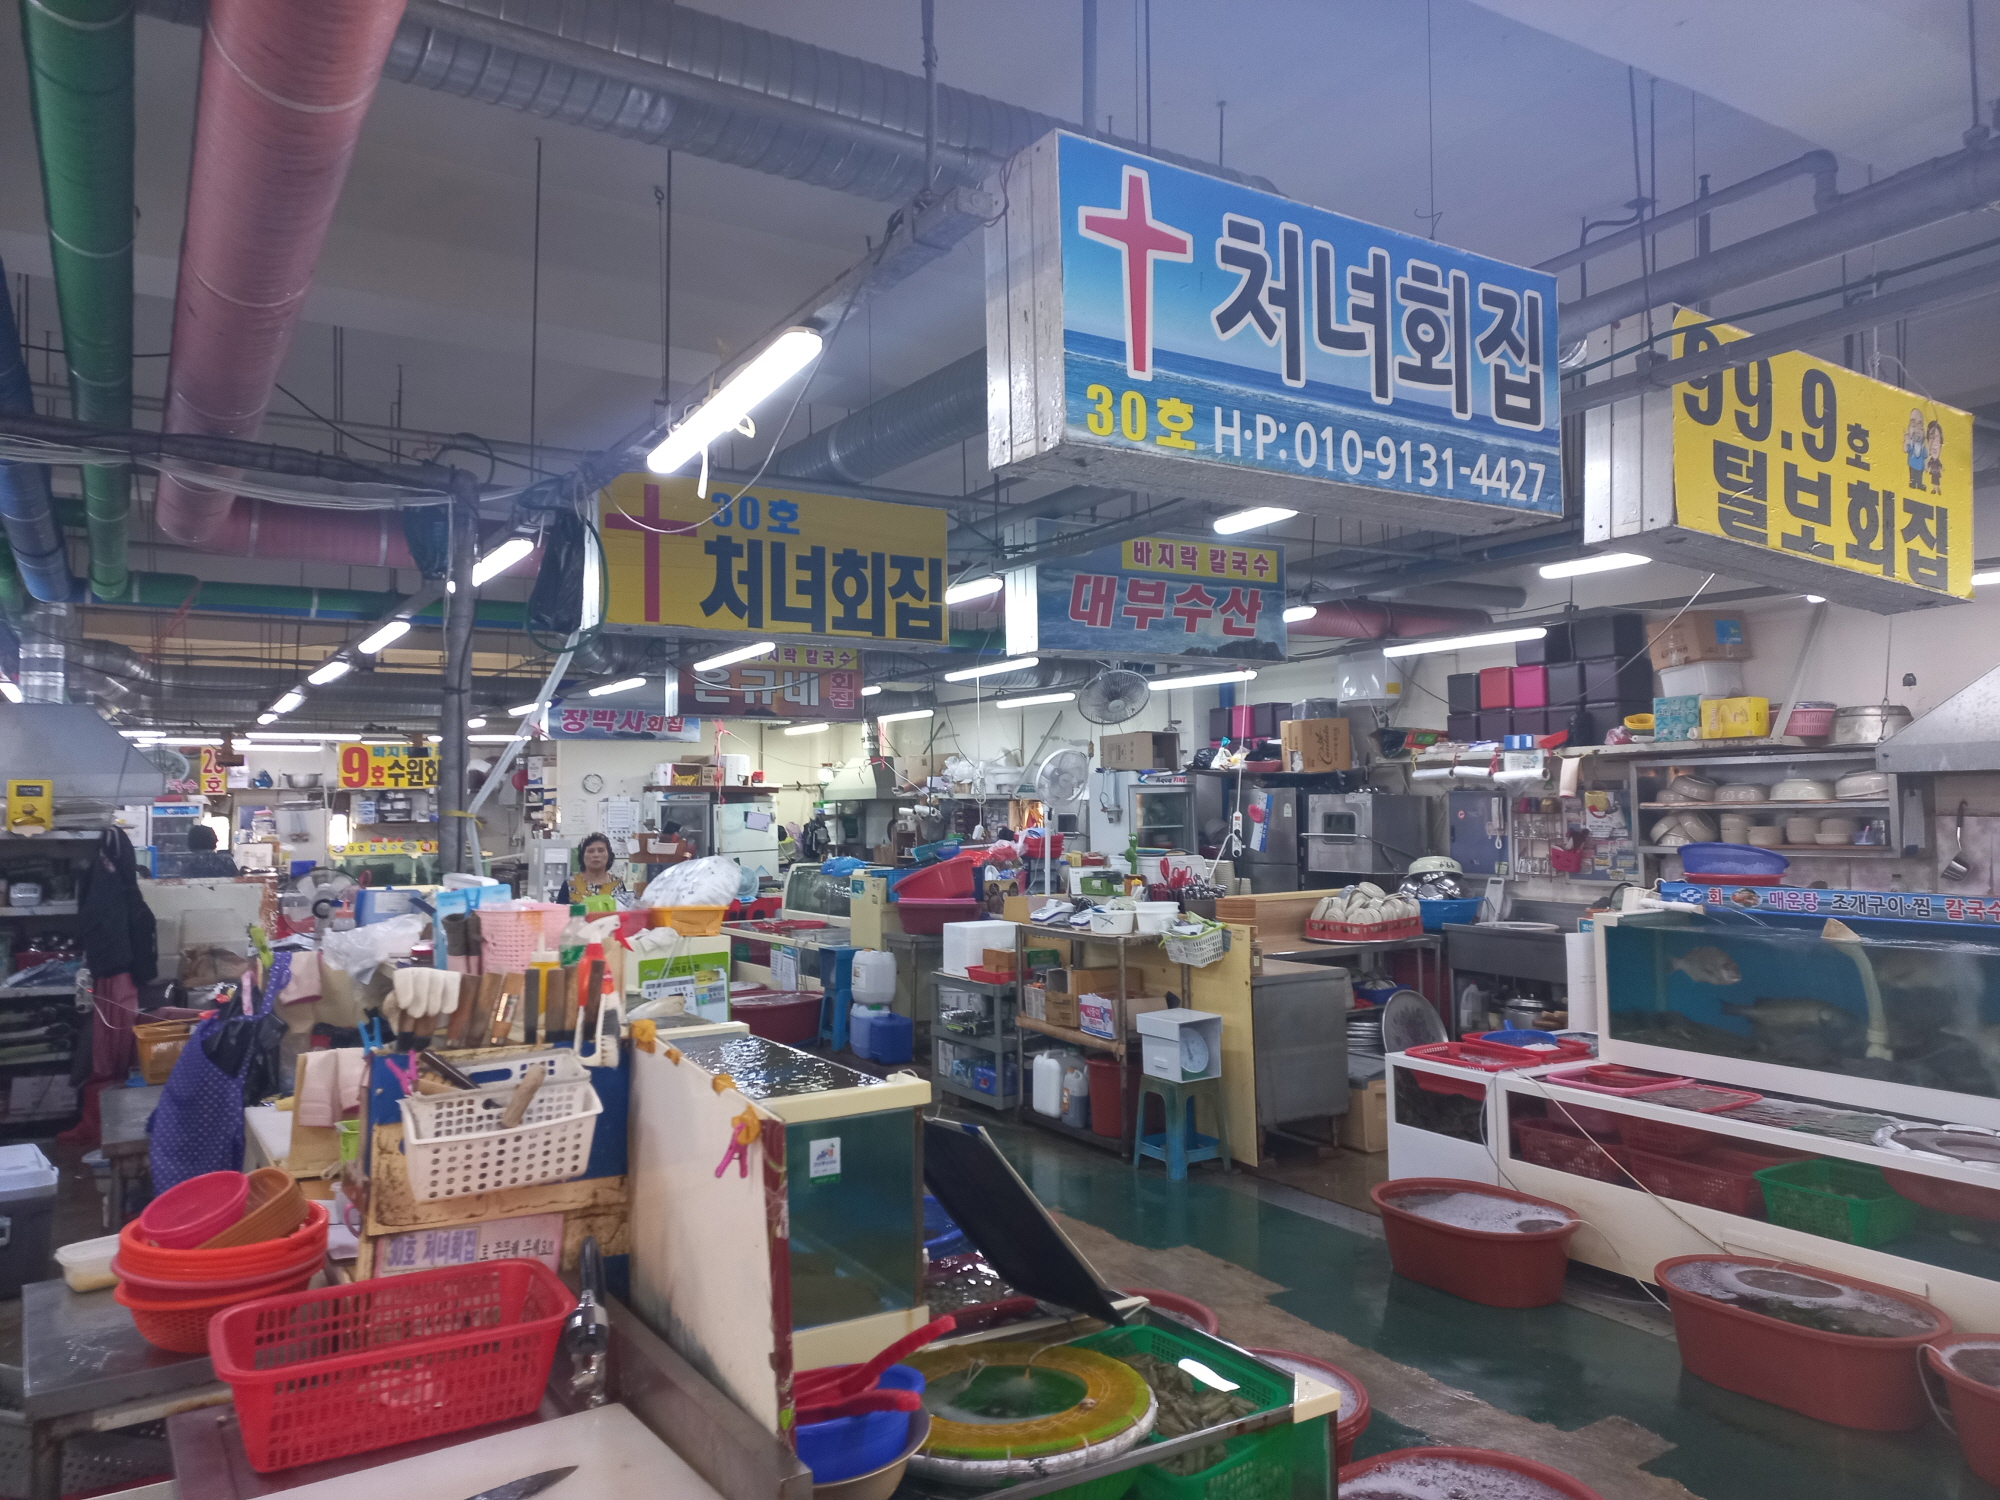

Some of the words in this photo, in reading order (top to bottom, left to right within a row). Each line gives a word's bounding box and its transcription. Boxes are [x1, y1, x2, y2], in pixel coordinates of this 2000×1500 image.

[1210, 213, 1546, 432] 처녀회집
[1085, 383, 1197, 451] 30호
[711, 492, 800, 535] 30호
[1713, 440, 1950, 591] 털보회집
[1133, 540, 1199, 571] 바지락
[1209, 546, 1270, 578] 칼국수
[699, 535, 943, 641] 처녀회집
[1069, 573, 1264, 638] 대부수산
[805, 649, 852, 666] 칼국수
[694, 667, 821, 706] 은규네
[829, 672, 855, 709] 회집
[203, 777, 224, 793] 호
[1707, 887, 1724, 906] 회
[1768, 890, 1820, 912] 매운탕
